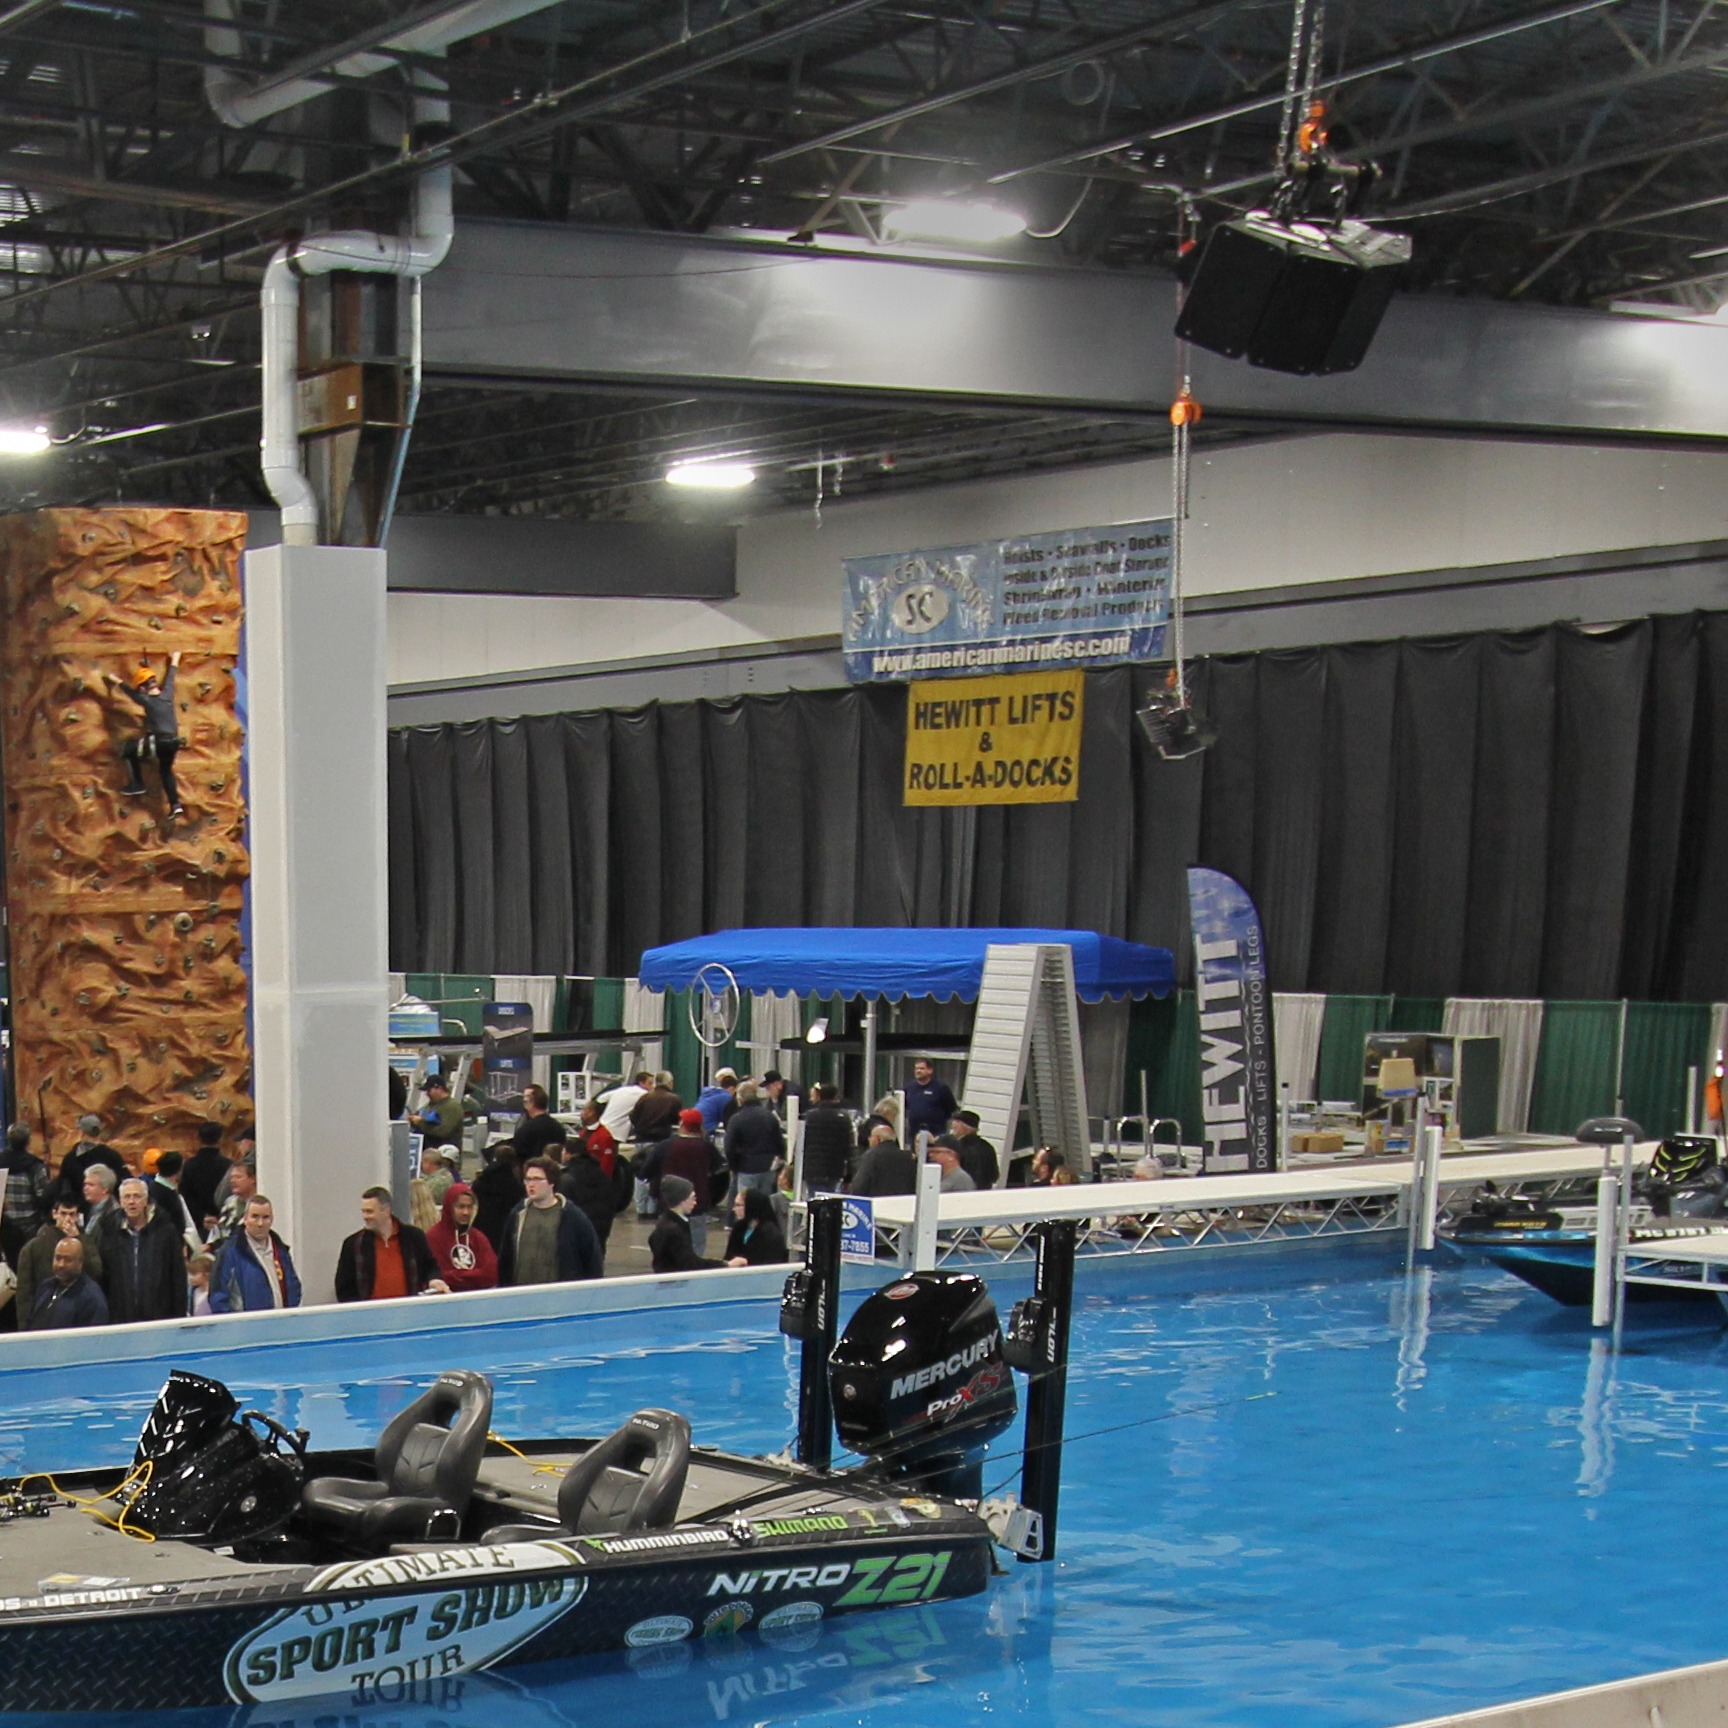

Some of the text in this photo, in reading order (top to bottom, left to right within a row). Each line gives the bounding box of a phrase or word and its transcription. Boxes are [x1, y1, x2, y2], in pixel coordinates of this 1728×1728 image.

[1128, 534, 1170, 551] Docks
[914, 691, 1077, 731] HEWITT LIFTS
[978, 732, 994, 753] &
[909, 757, 1074, 790] ROLL-A-DOCKS
[1194, 933, 1250, 1174] HEWITT
[1246, 925, 1268, 1170] DOCKS LIFTS PONTOON LEGS
[890, 1329, 1000, 1401] MERCURY
[602, 1515, 849, 1554] HUMMINBIRD SHIMANO
[43, 1587, 142, 1608] DETROIT
[831, 1551, 953, 1607] Z21
[245, 1577, 566, 1687] SPORT SHOW
[350, 1643, 466, 1700] TOUR
